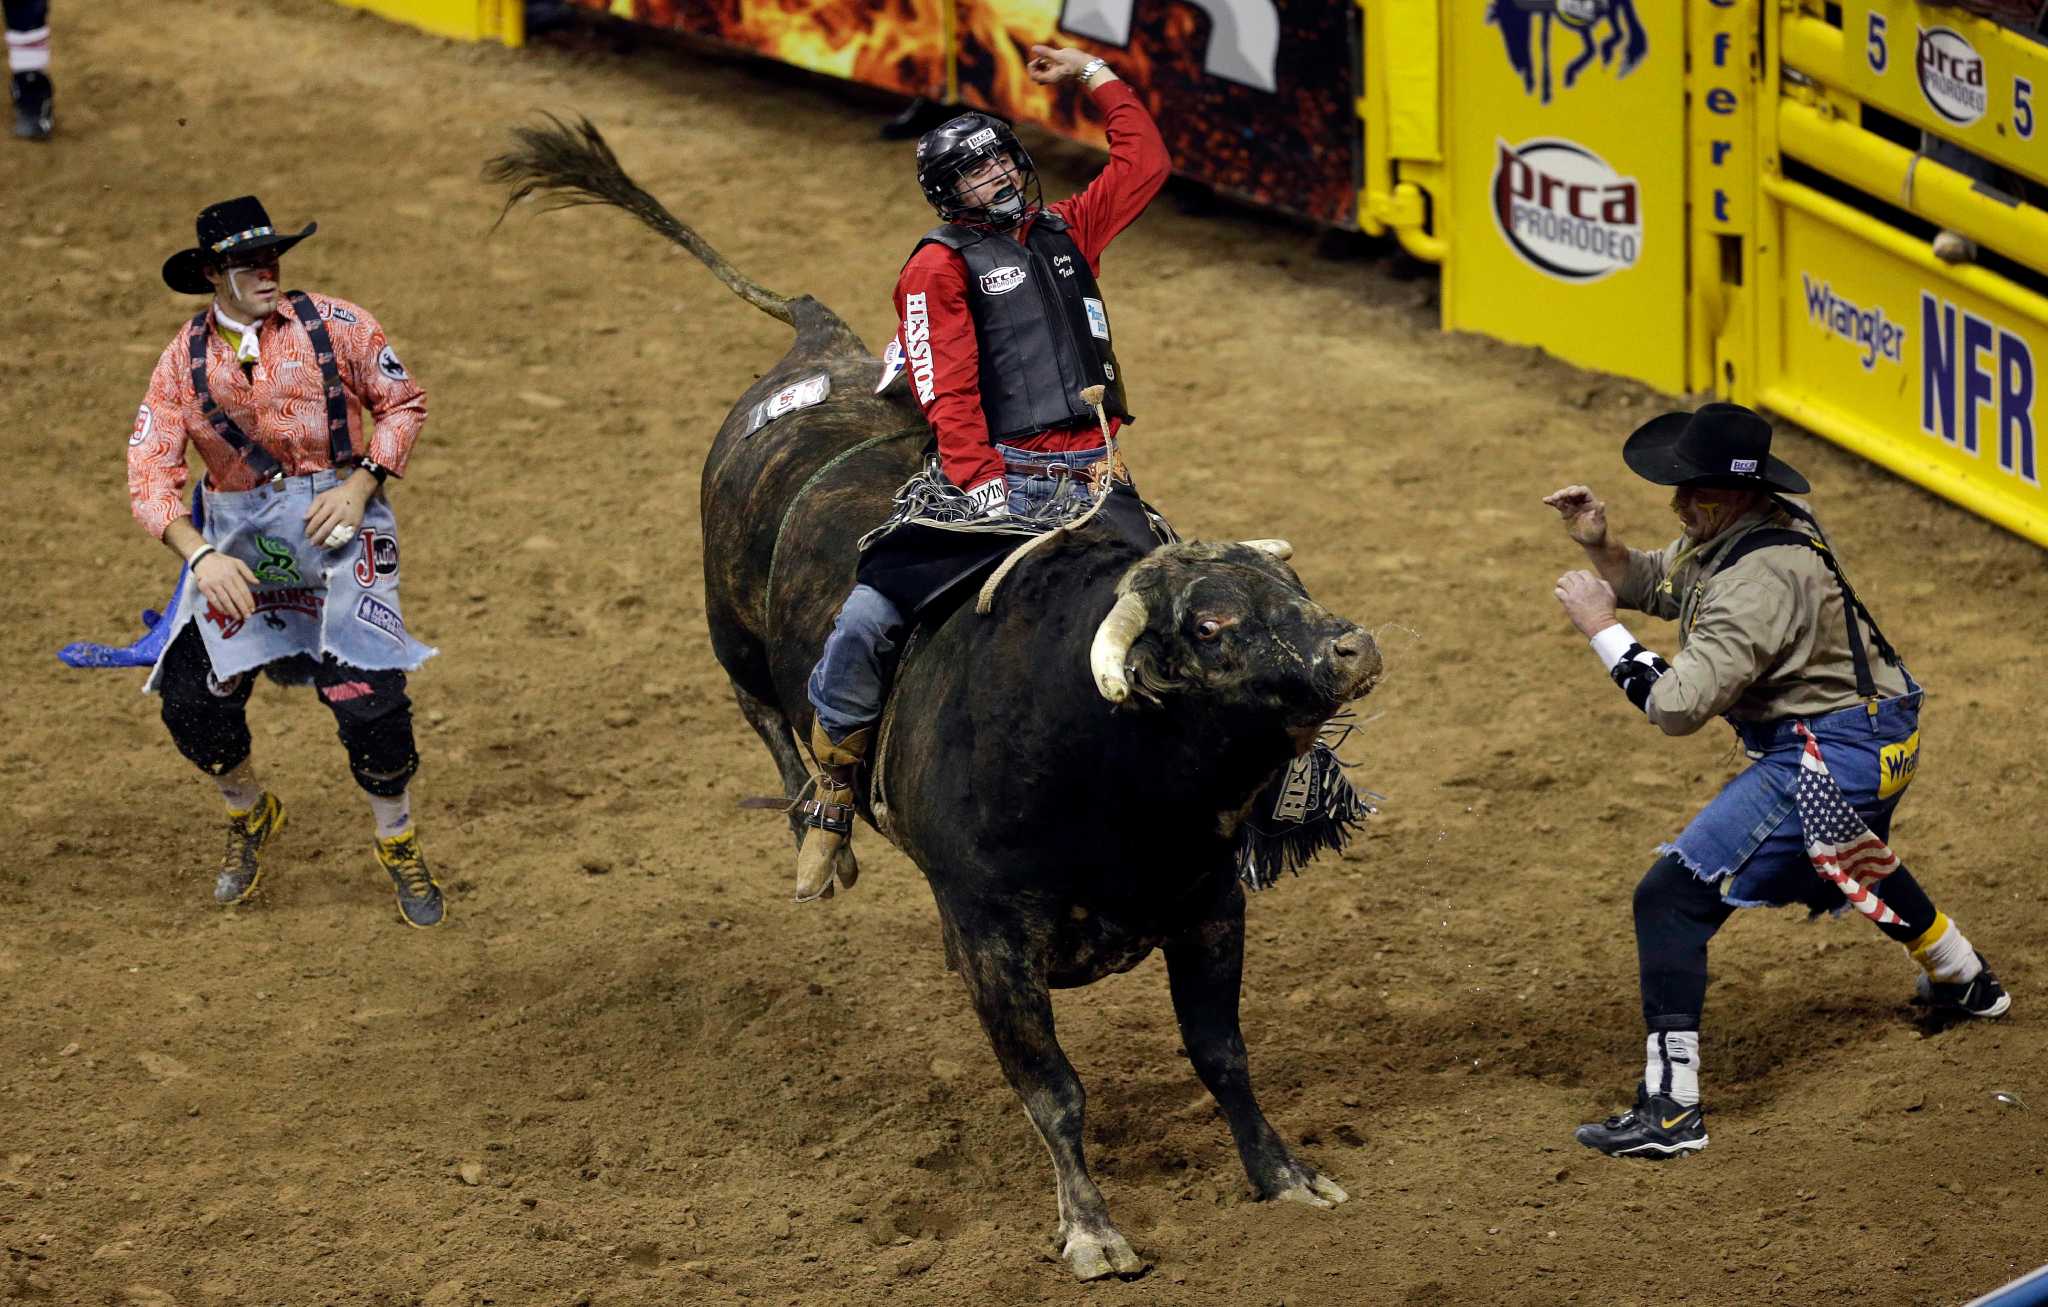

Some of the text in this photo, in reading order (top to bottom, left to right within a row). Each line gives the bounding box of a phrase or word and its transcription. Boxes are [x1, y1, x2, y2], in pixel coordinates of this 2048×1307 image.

[1867, 12, 1887, 73] 5
[1917, 28, 1984, 88] prca
[1706, 0, 1738, 222] fert
[2013, 77, 2033, 138] 5
[1500, 147, 1638, 233] prca
[1510, 202, 1638, 264] PRORODEO
[983, 267, 1021, 291] prca
[906, 291, 936, 405] HESSTON
[1802, 273, 1904, 369] Wrangler
[1920, 293, 2038, 485] NFR
